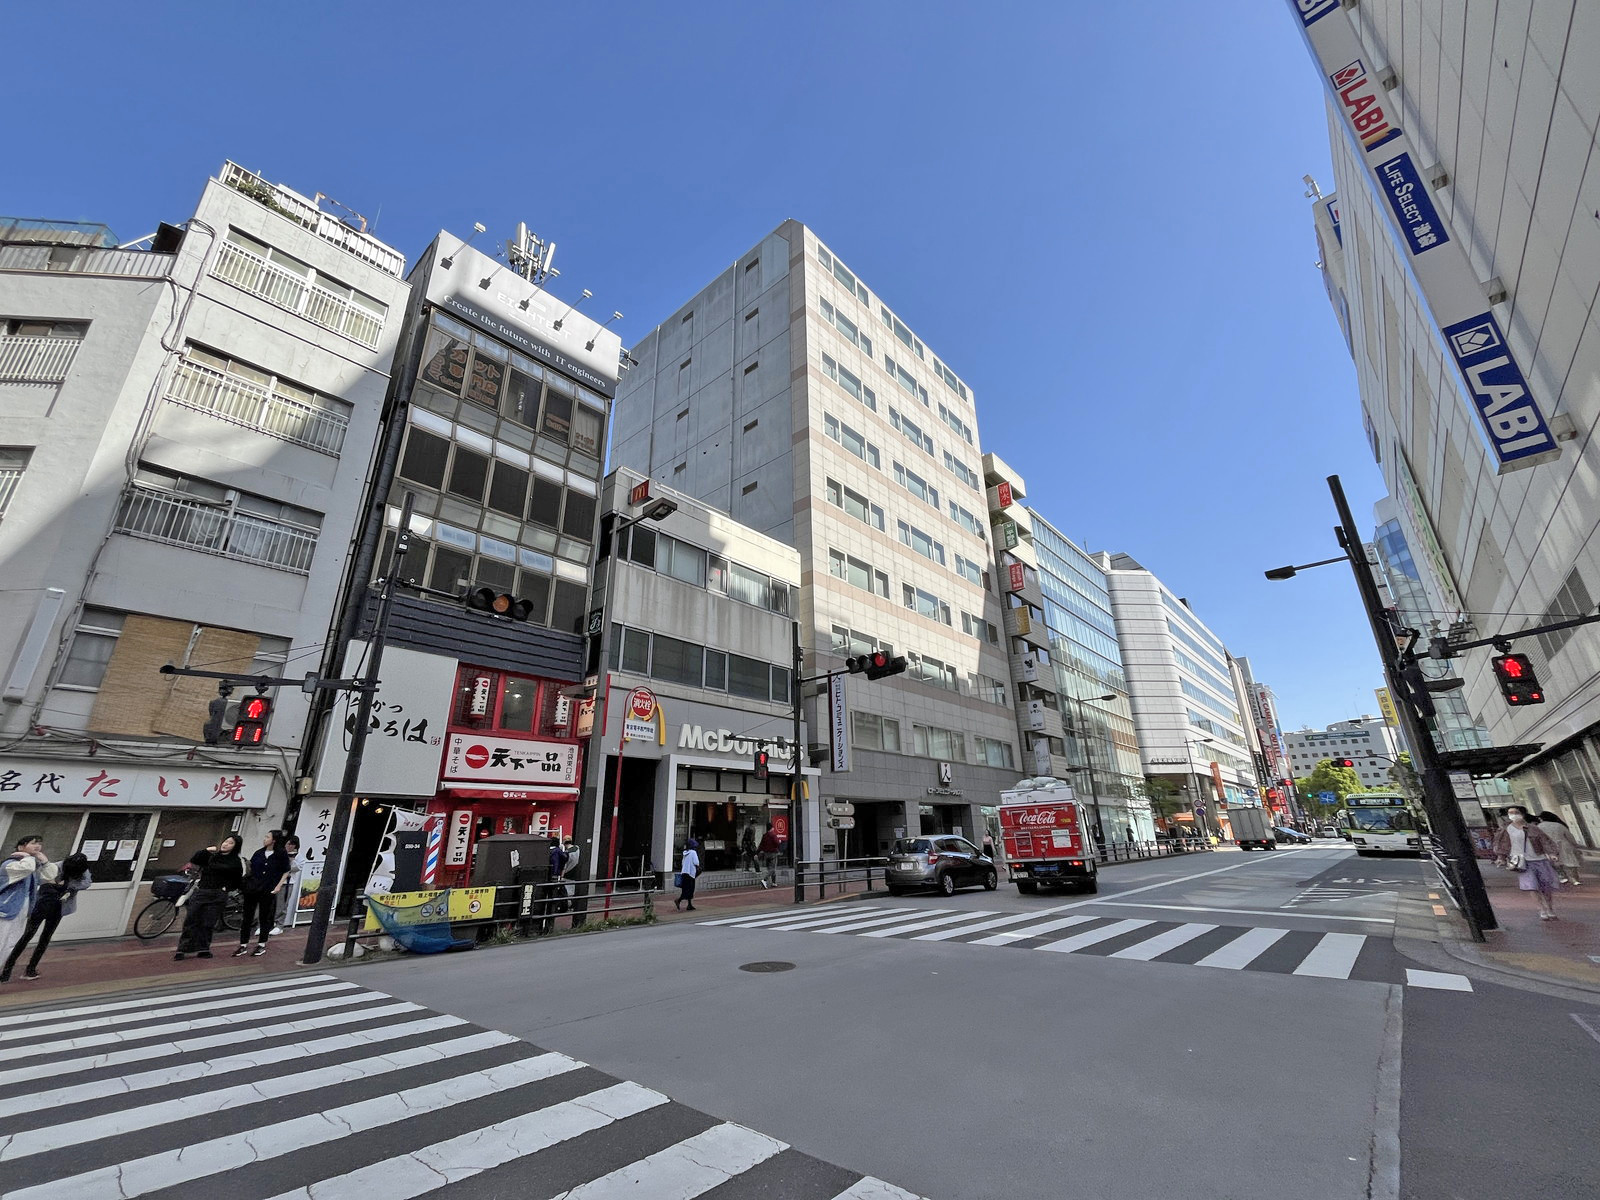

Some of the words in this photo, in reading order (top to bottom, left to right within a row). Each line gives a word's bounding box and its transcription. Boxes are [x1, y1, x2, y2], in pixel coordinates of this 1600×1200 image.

[1340, 78, 1389, 140] LABI
[443, 294, 478, 318] Create
[480, 314, 497, 329] the
[498, 324, 528, 346] future
[531, 342, 551, 358] with
[555, 354, 567, 366] IT
[567, 363, 606, 388] engineers
[1465, 355, 1548, 454] LABI
[633, 698, 652, 710] 消火栓
[450, 738, 463, 774] 中華そば
[489, 747, 562, 772] 天下一品
[0, 769, 66, 794] 名代
[82, 769, 247, 803] たい焼
[315, 808, 332, 842] 牛かつ
[452, 826, 468, 862] 天下一品
